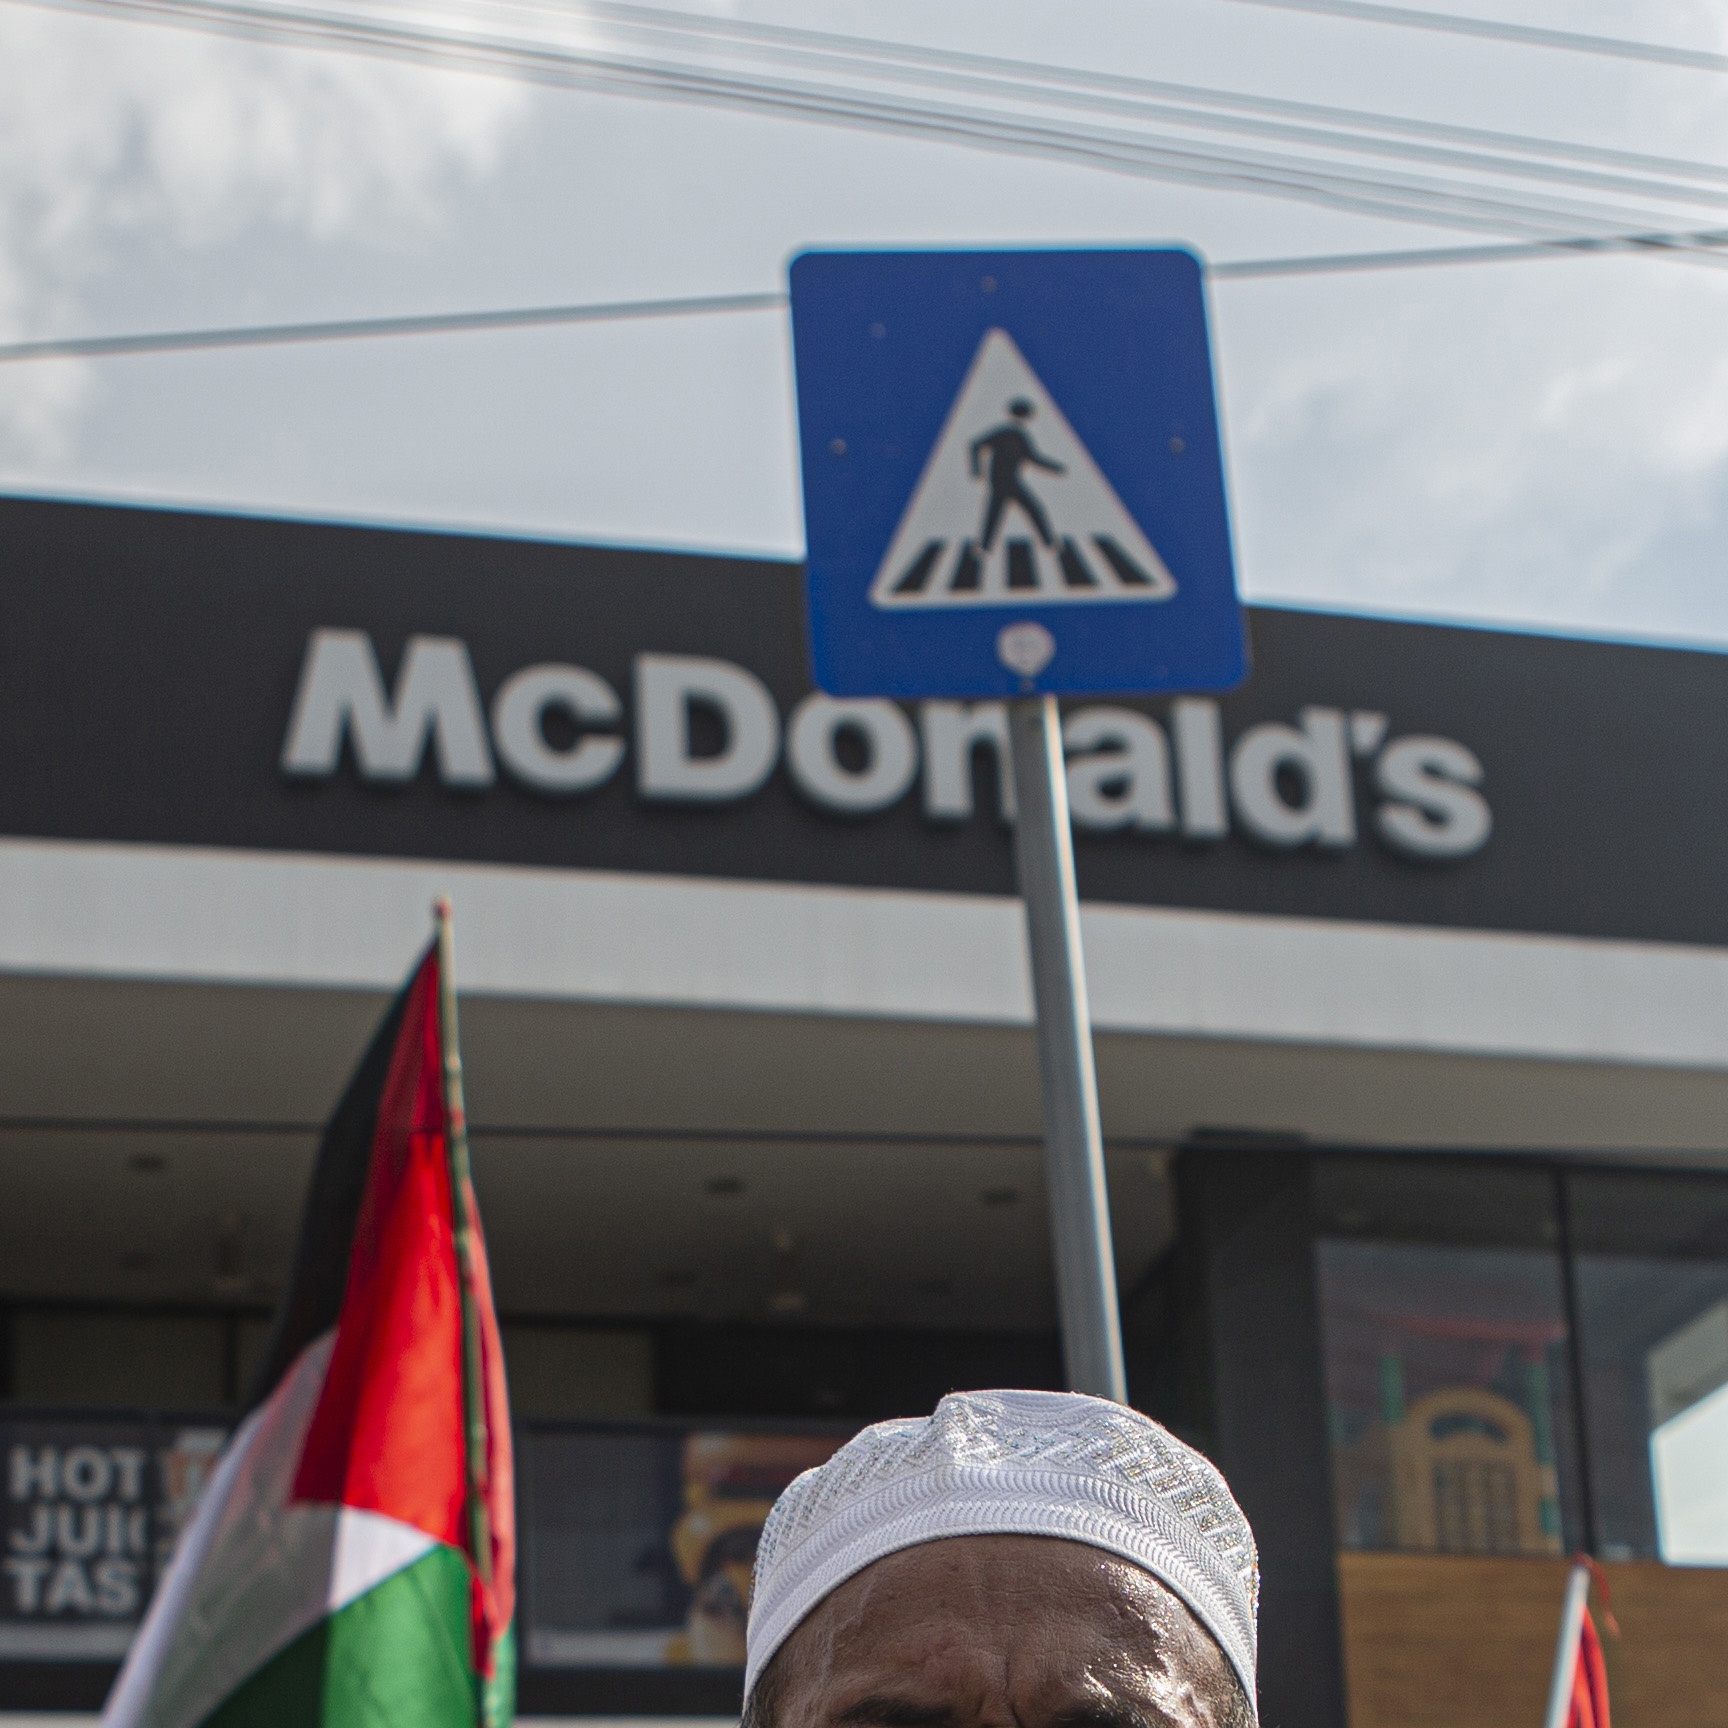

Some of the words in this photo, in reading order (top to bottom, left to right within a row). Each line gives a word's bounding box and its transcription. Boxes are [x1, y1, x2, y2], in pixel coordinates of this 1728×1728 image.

[282, 625, 1494, 860] McDonald's
[7, 1445, 145, 1502] HOT
[2, 1558, 150, 1616] TAS
